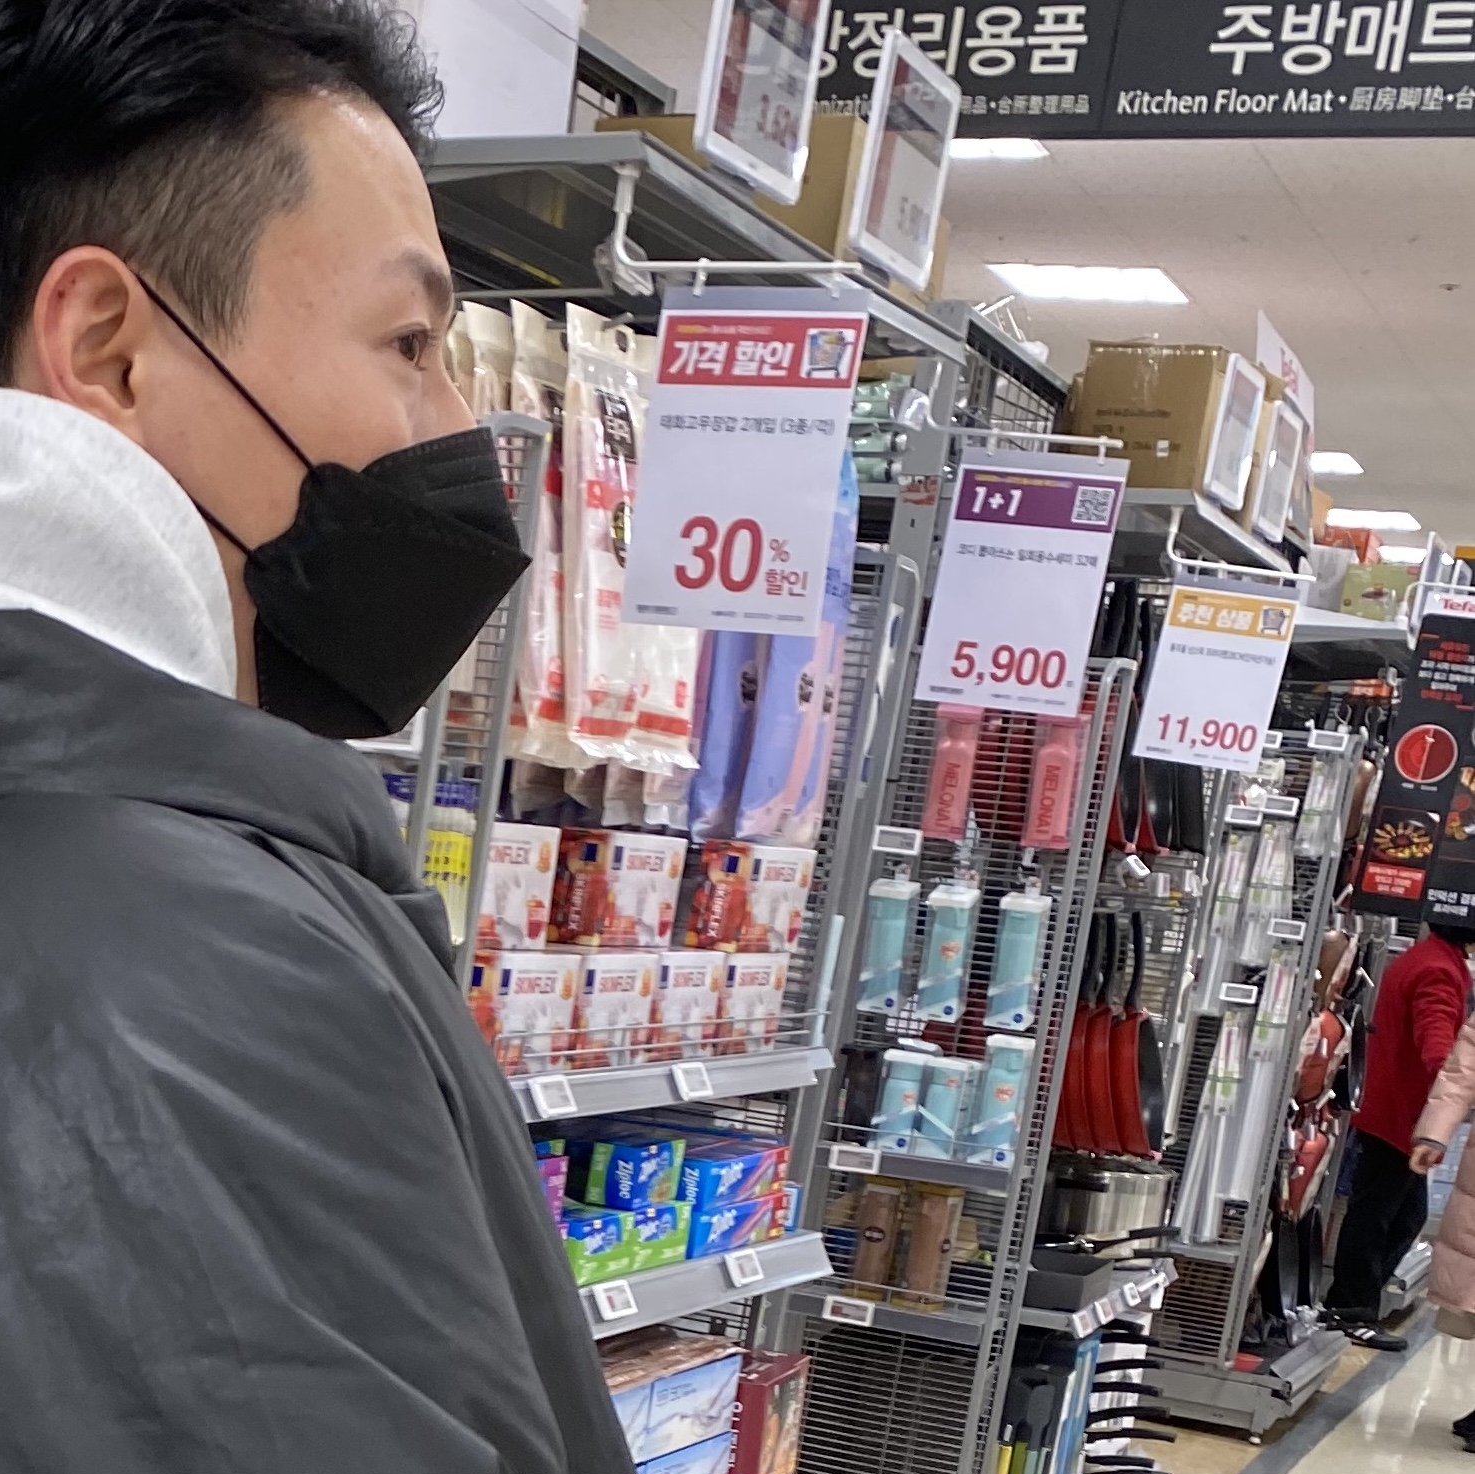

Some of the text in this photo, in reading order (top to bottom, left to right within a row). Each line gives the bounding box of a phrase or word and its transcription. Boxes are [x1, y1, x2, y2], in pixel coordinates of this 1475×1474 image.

[1209, 0, 1475, 75] 주방매트
[1116, 88, 1334, 114] Kitchen Floor Mat
[666, 340, 794, 377] 가격 할인
[972, 486, 1022, 517] 1+1
[675, 515, 791, 592] 30 %
[765, 568, 809, 598] 할인
[951, 640, 1067, 689] 5,900
[1158, 713, 1257, 752] 11,900
[615, 1159, 634, 1199] Ziploc
